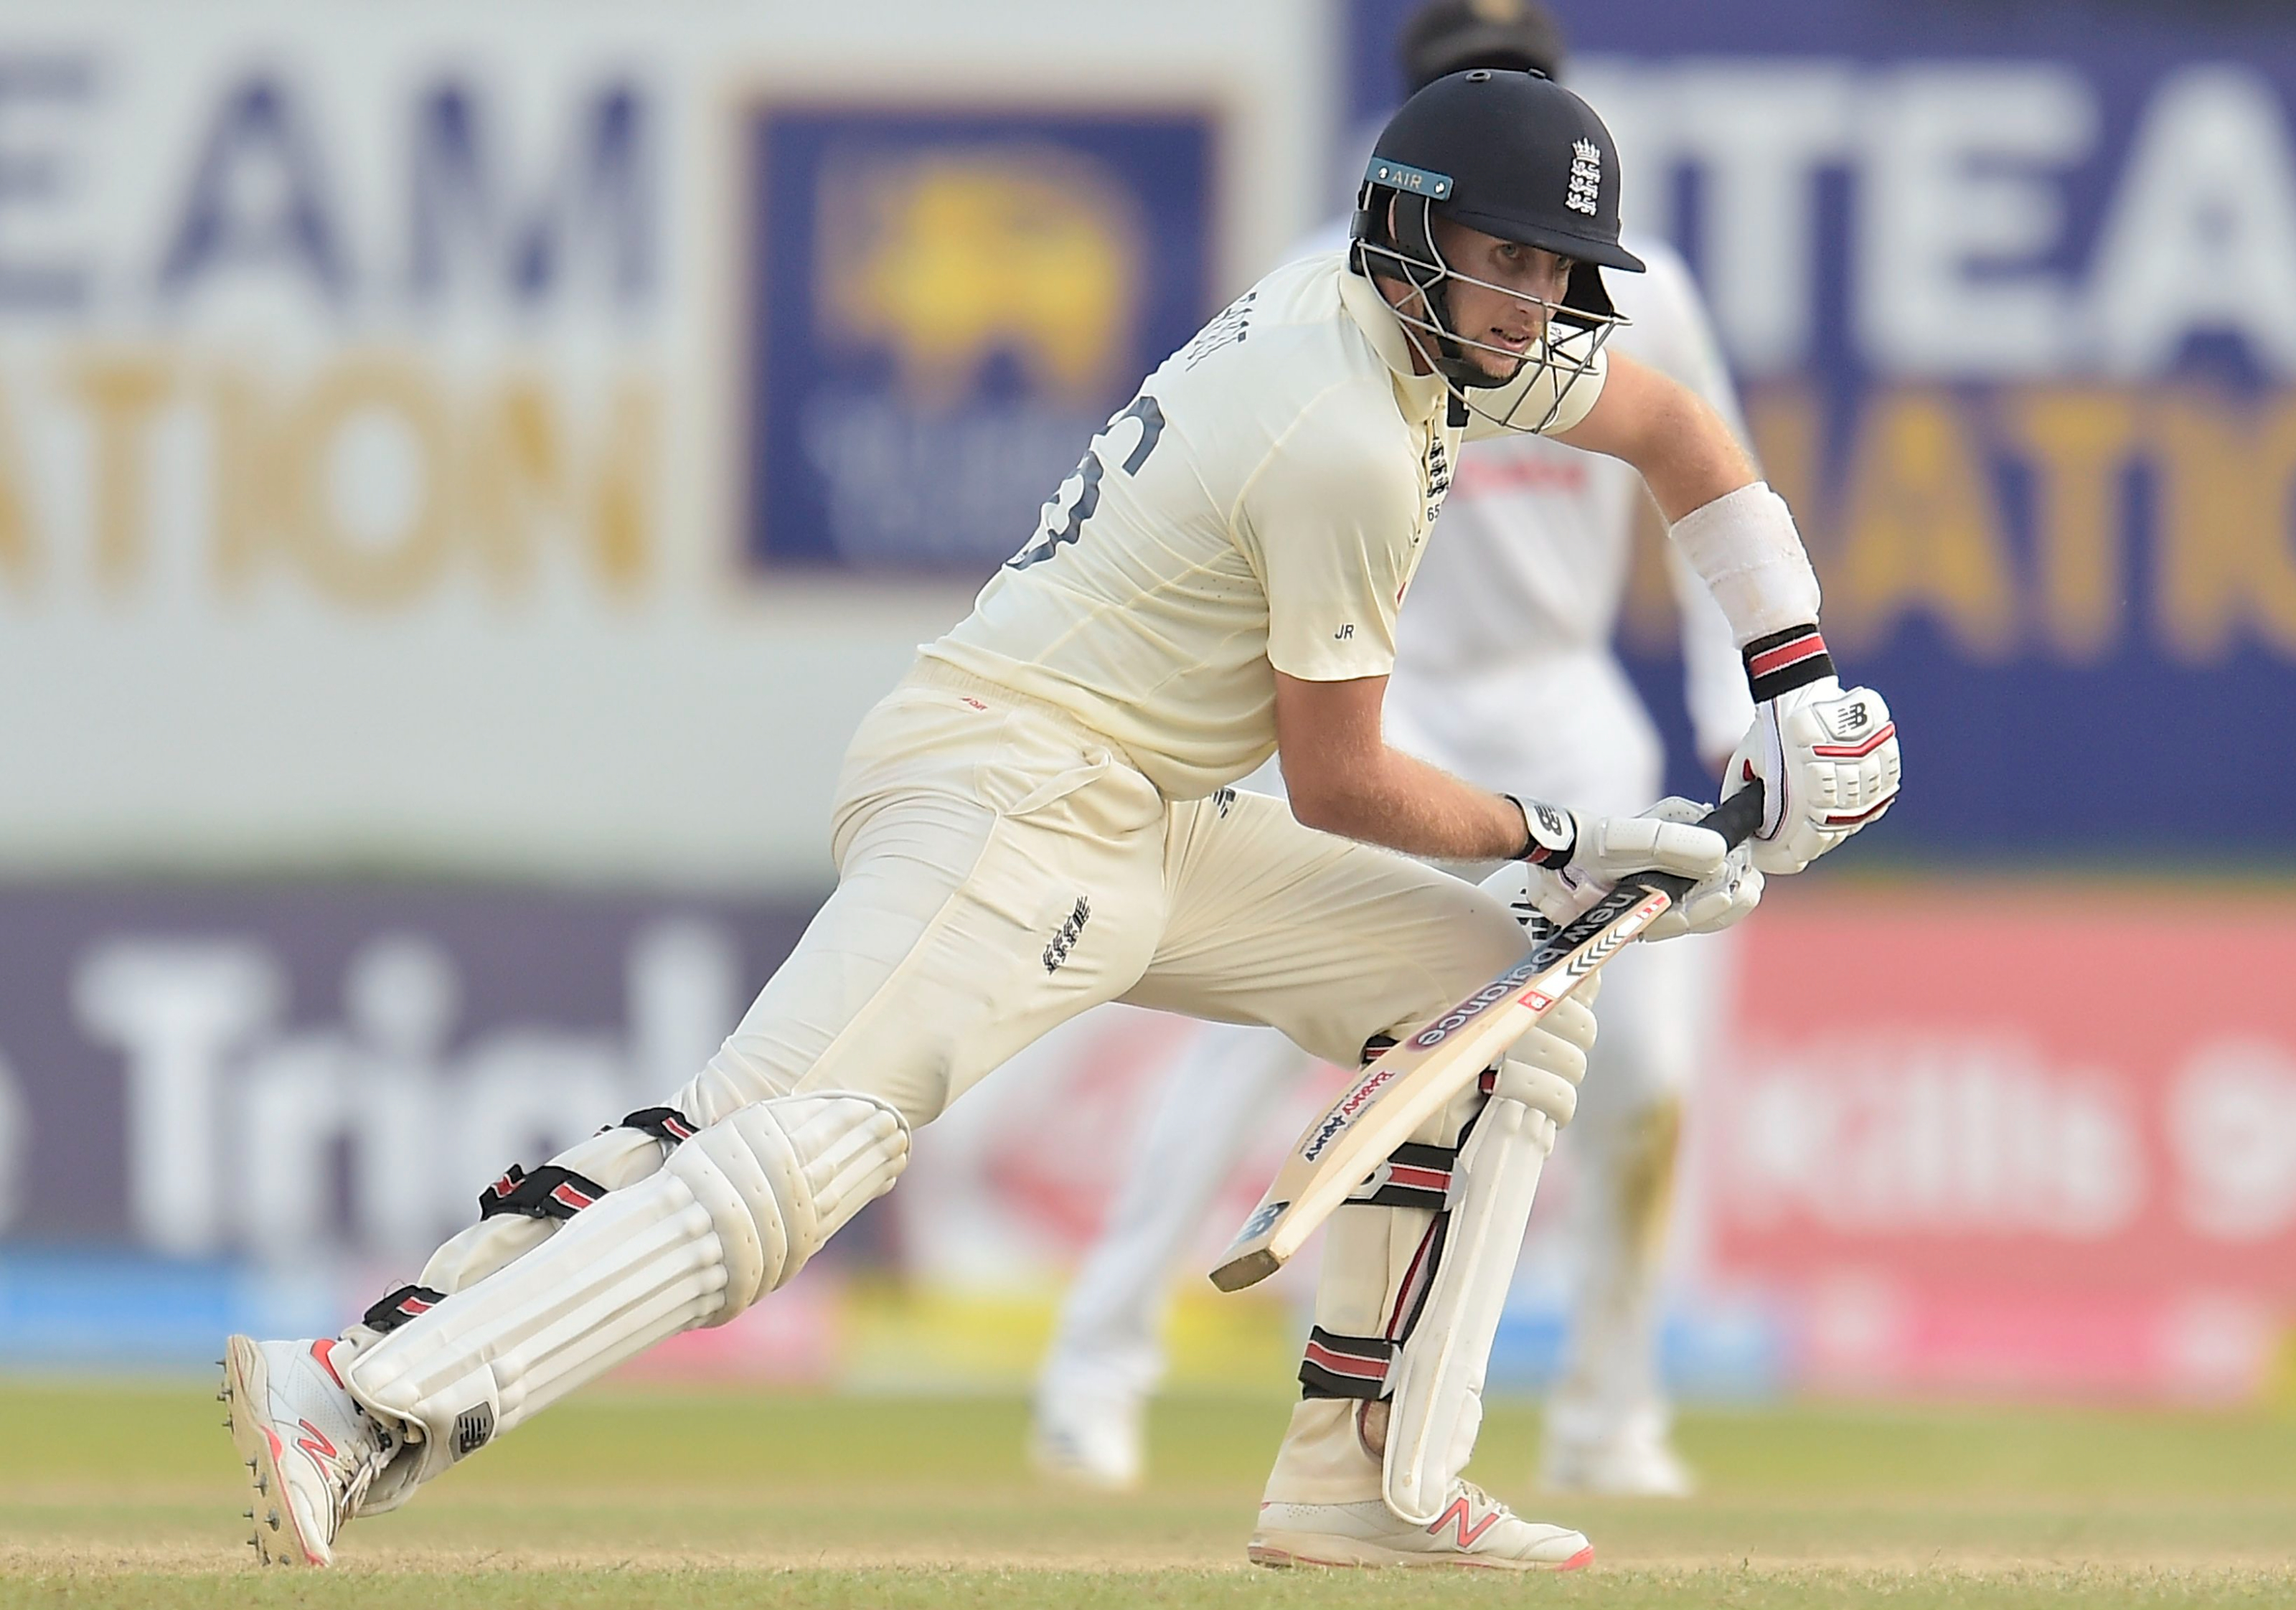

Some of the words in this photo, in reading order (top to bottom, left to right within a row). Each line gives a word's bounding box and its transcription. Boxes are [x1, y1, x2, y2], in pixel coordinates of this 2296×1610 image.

[1391, 170, 1423, 189] AIR
[1334, 623, 1355, 639] JR
[1564, 891, 1637, 943] new
[1416, 944, 1568, 1048] balance
